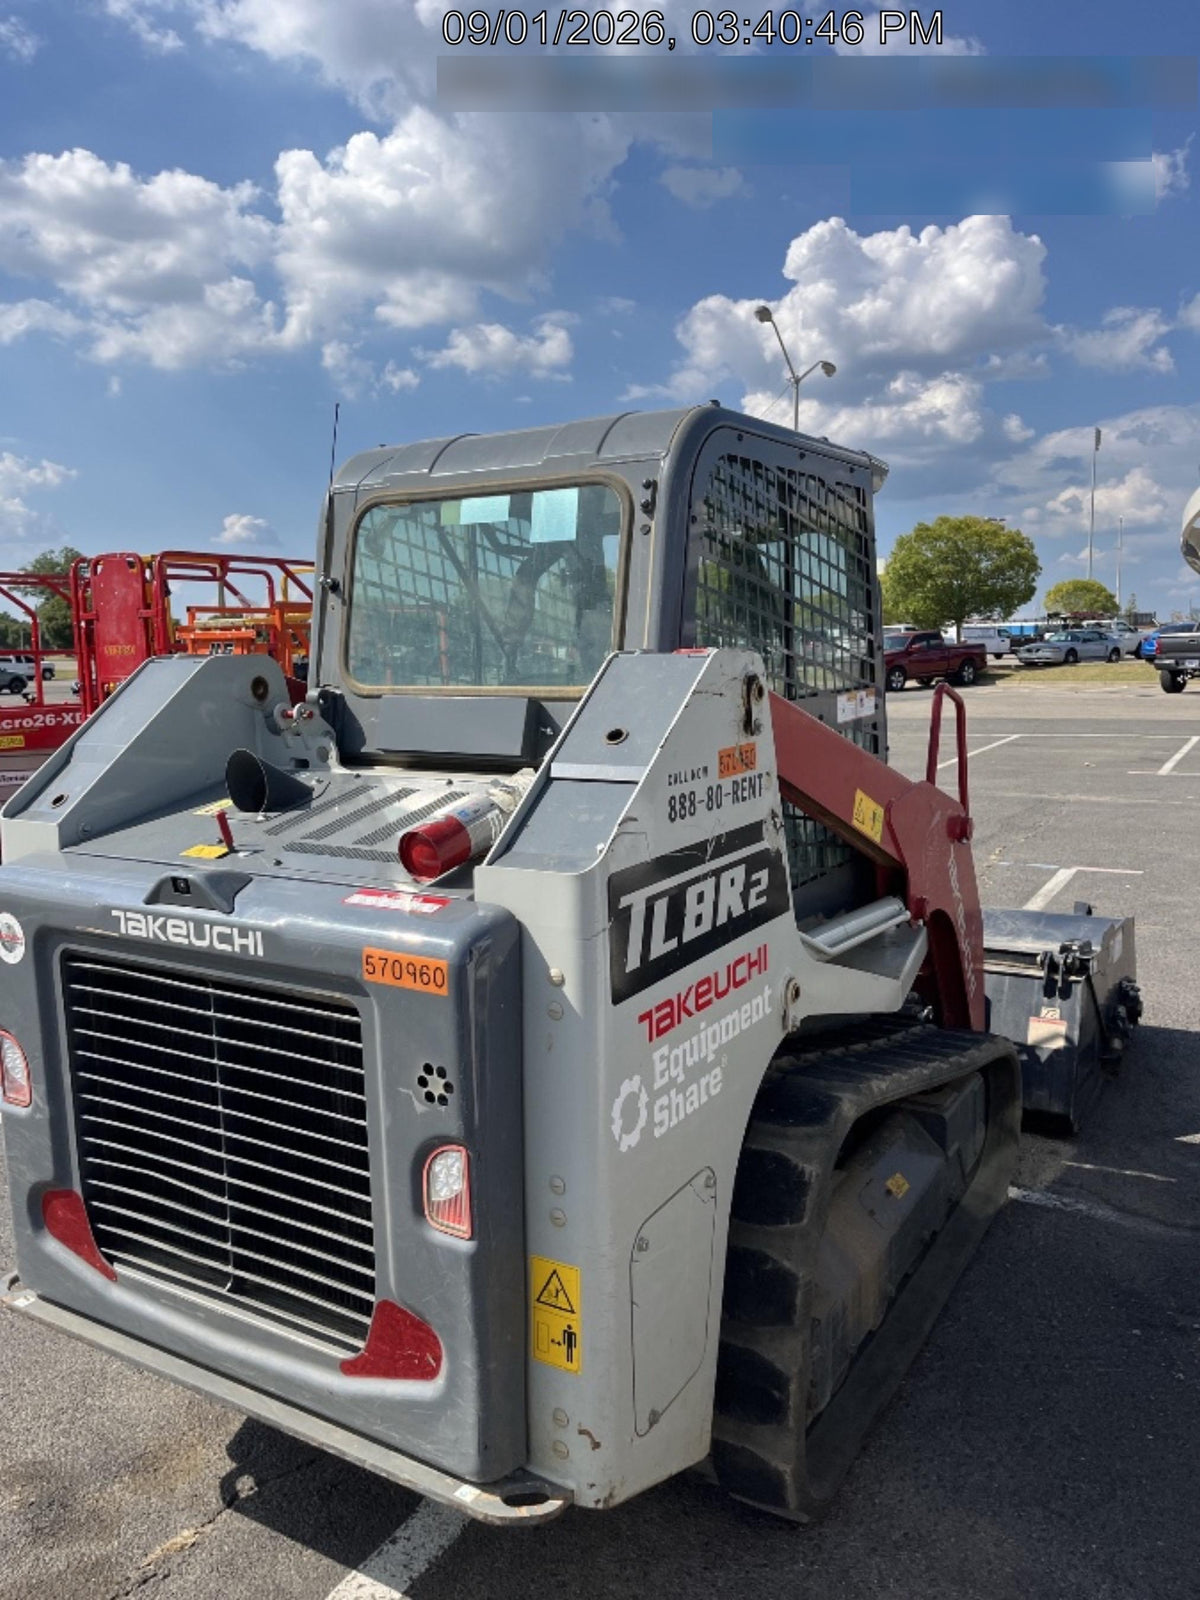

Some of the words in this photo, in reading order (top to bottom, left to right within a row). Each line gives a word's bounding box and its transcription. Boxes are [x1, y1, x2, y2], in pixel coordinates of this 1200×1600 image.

[668, 773, 764, 823] 888-80-RENT
[617, 844, 769, 974] TL8R2
[365, 954, 446, 989] 570960
[652, 984, 773, 1091] Equipment
